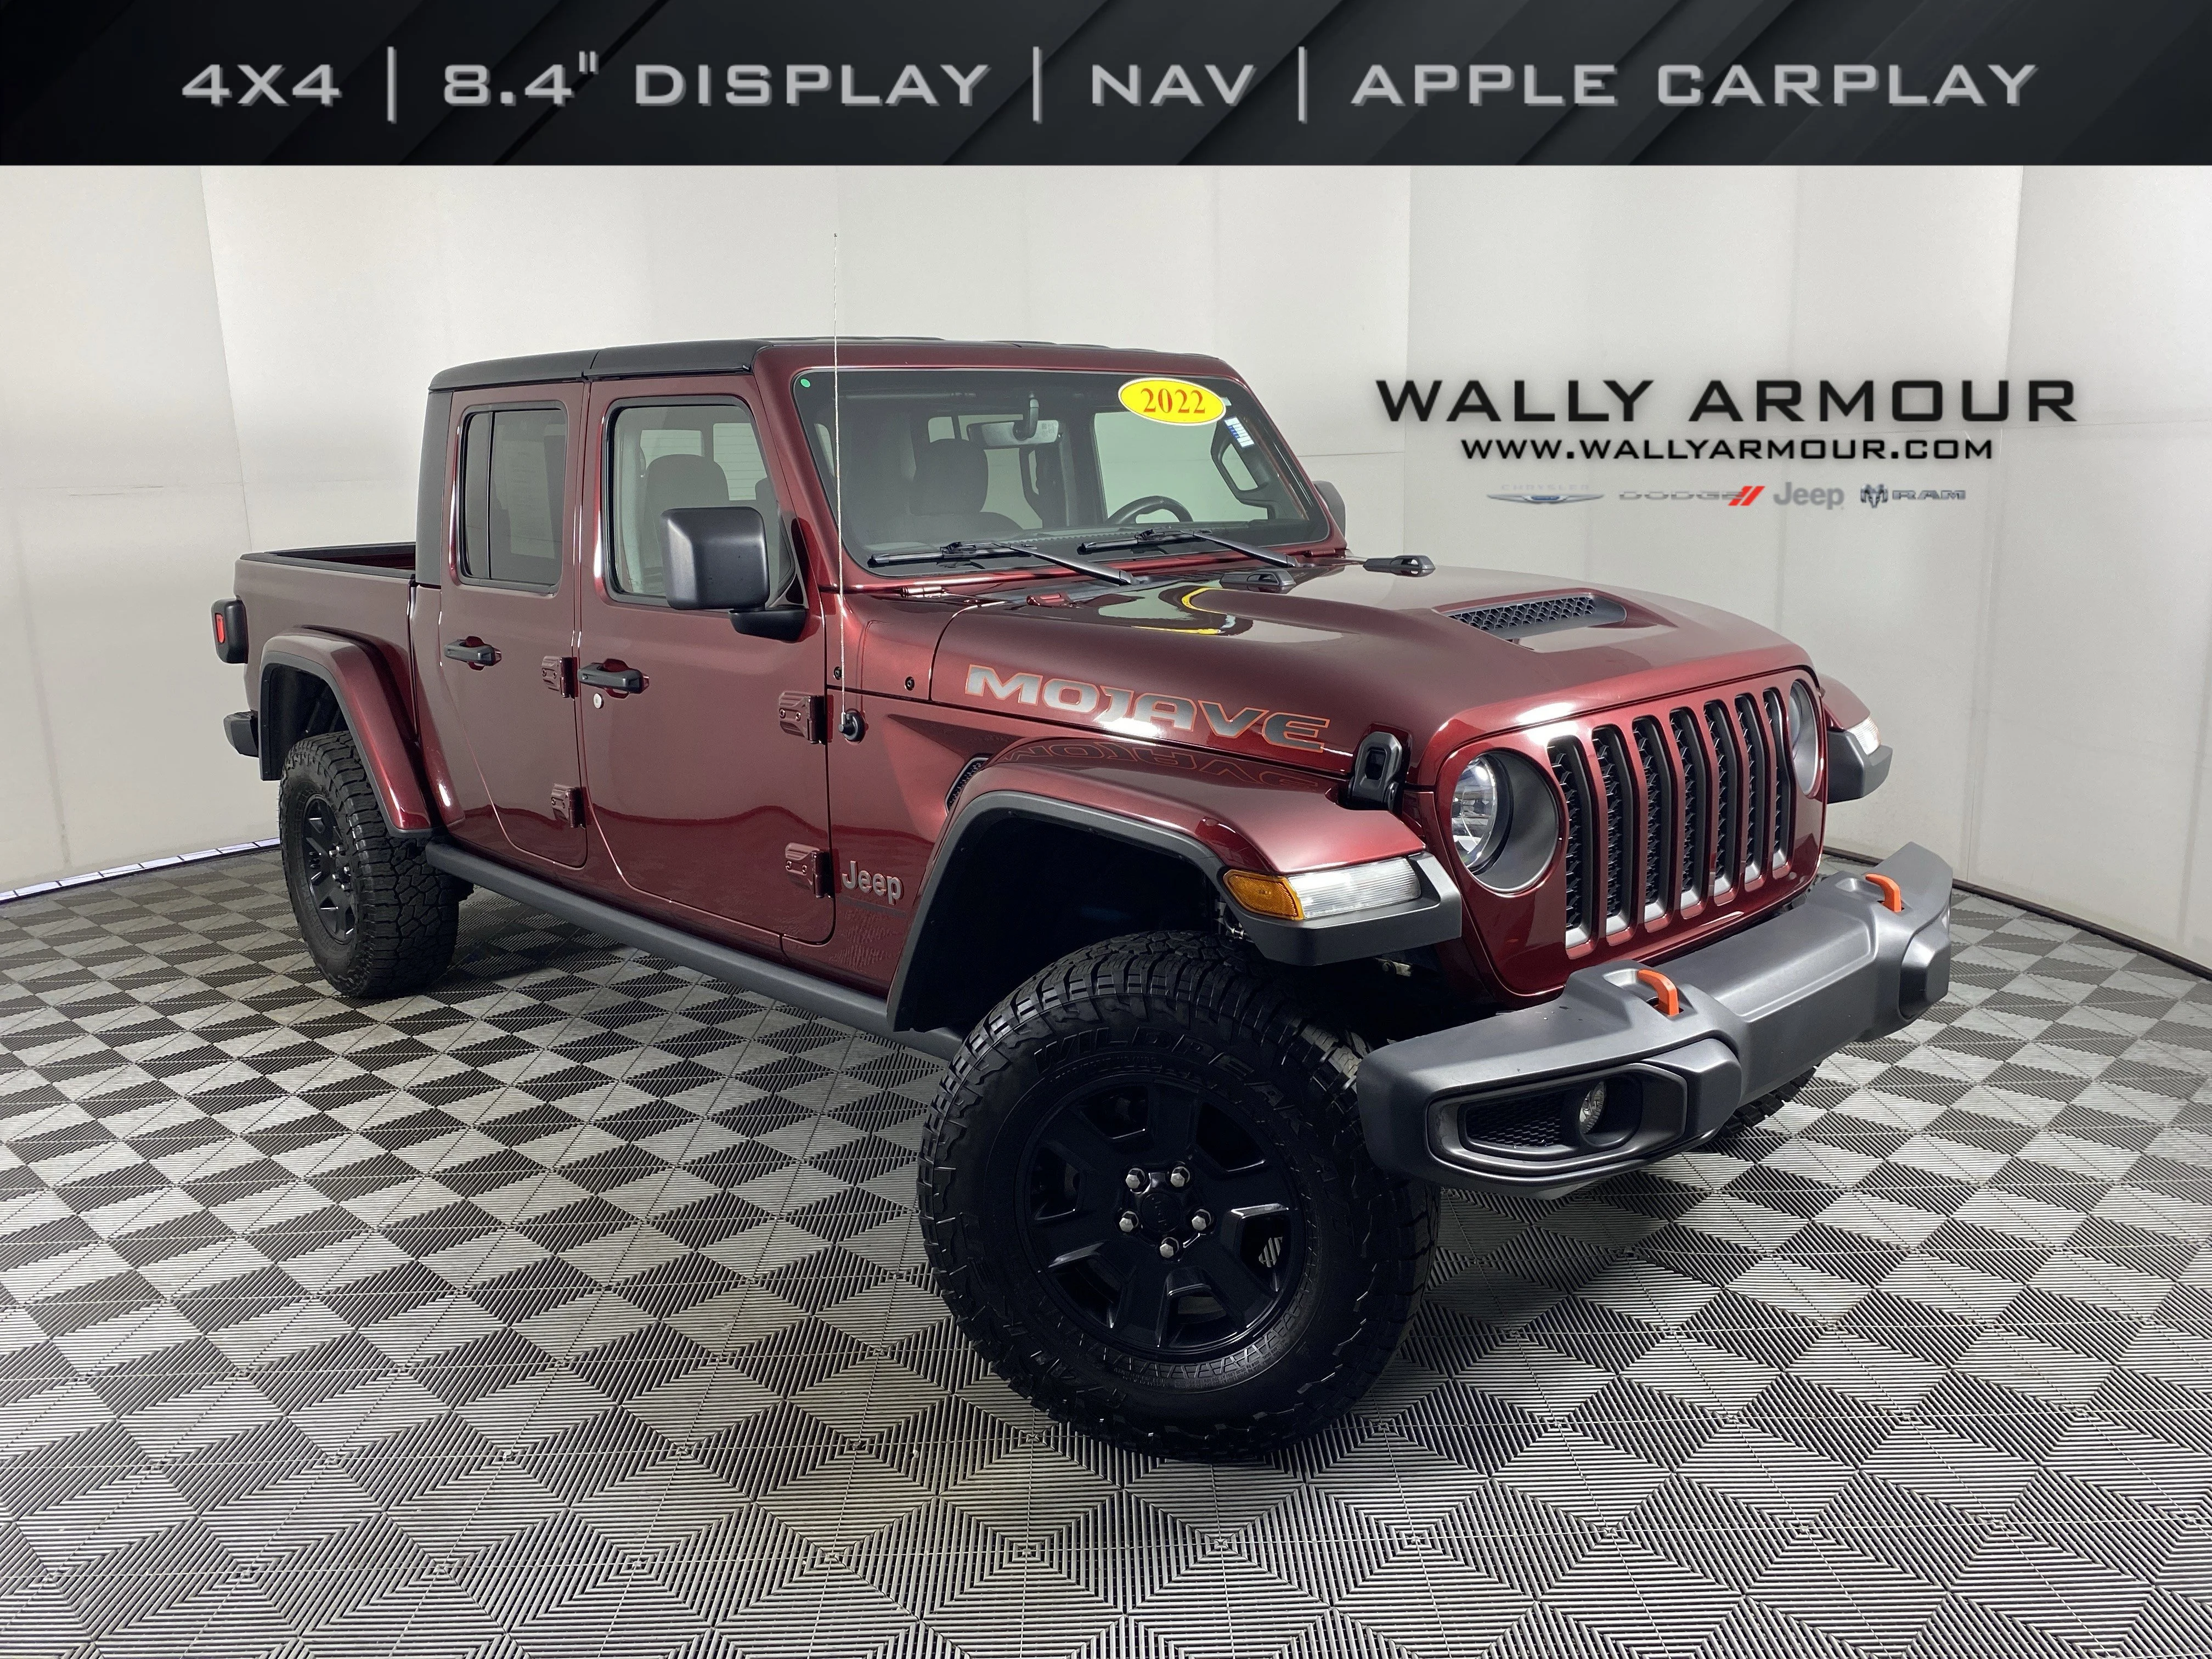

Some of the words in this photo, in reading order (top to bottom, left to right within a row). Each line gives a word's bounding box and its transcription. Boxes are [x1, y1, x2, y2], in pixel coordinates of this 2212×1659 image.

[1141, 388, 1205, 414] 2022
[964, 664, 1330, 753] MOJAVE
[842, 860, 904, 905] Jeep
[1034, 1026, 1318, 1138] WILDPEAK
